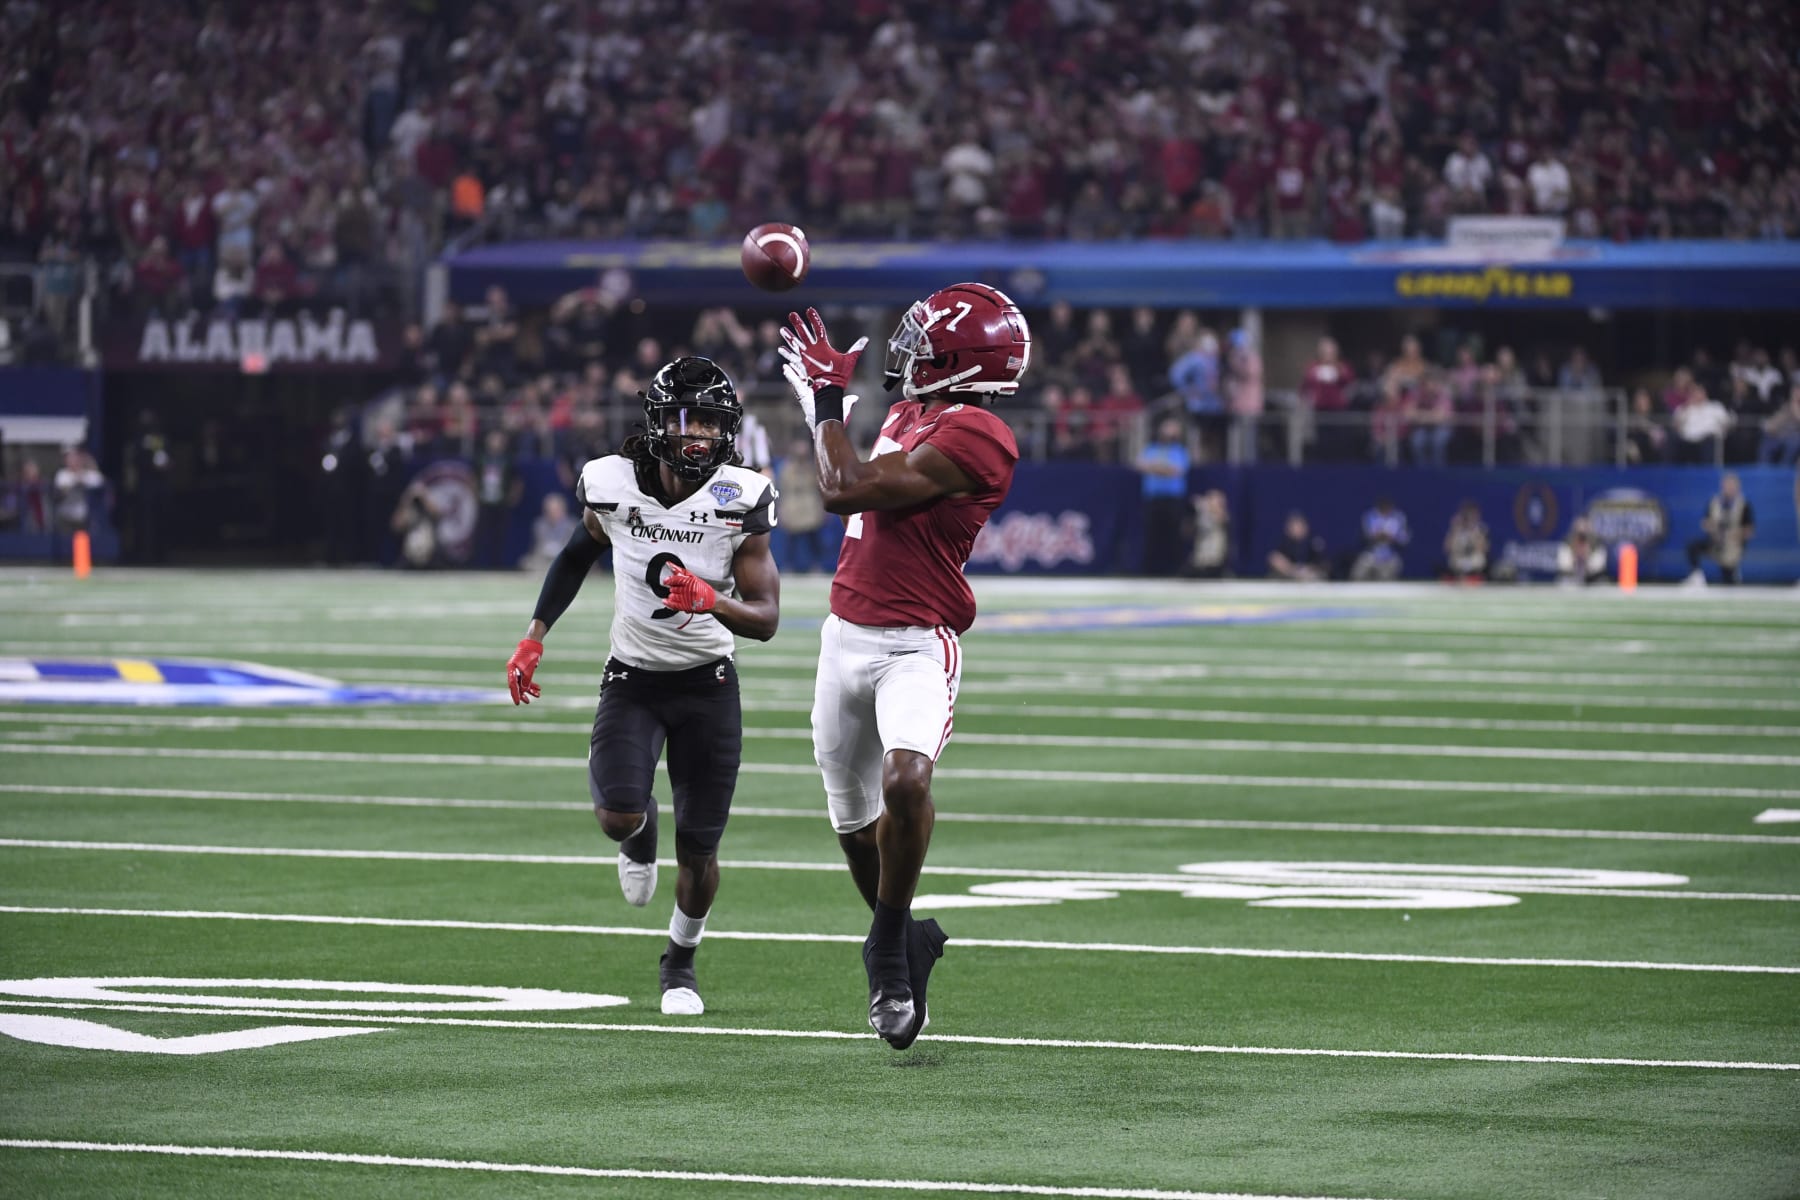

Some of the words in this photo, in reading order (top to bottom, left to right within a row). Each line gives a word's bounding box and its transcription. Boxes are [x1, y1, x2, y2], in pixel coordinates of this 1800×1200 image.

[945, 301, 973, 333] 7
[139, 318, 379, 361] ALABAMA
[631, 525, 705, 544] CINCINNATI
